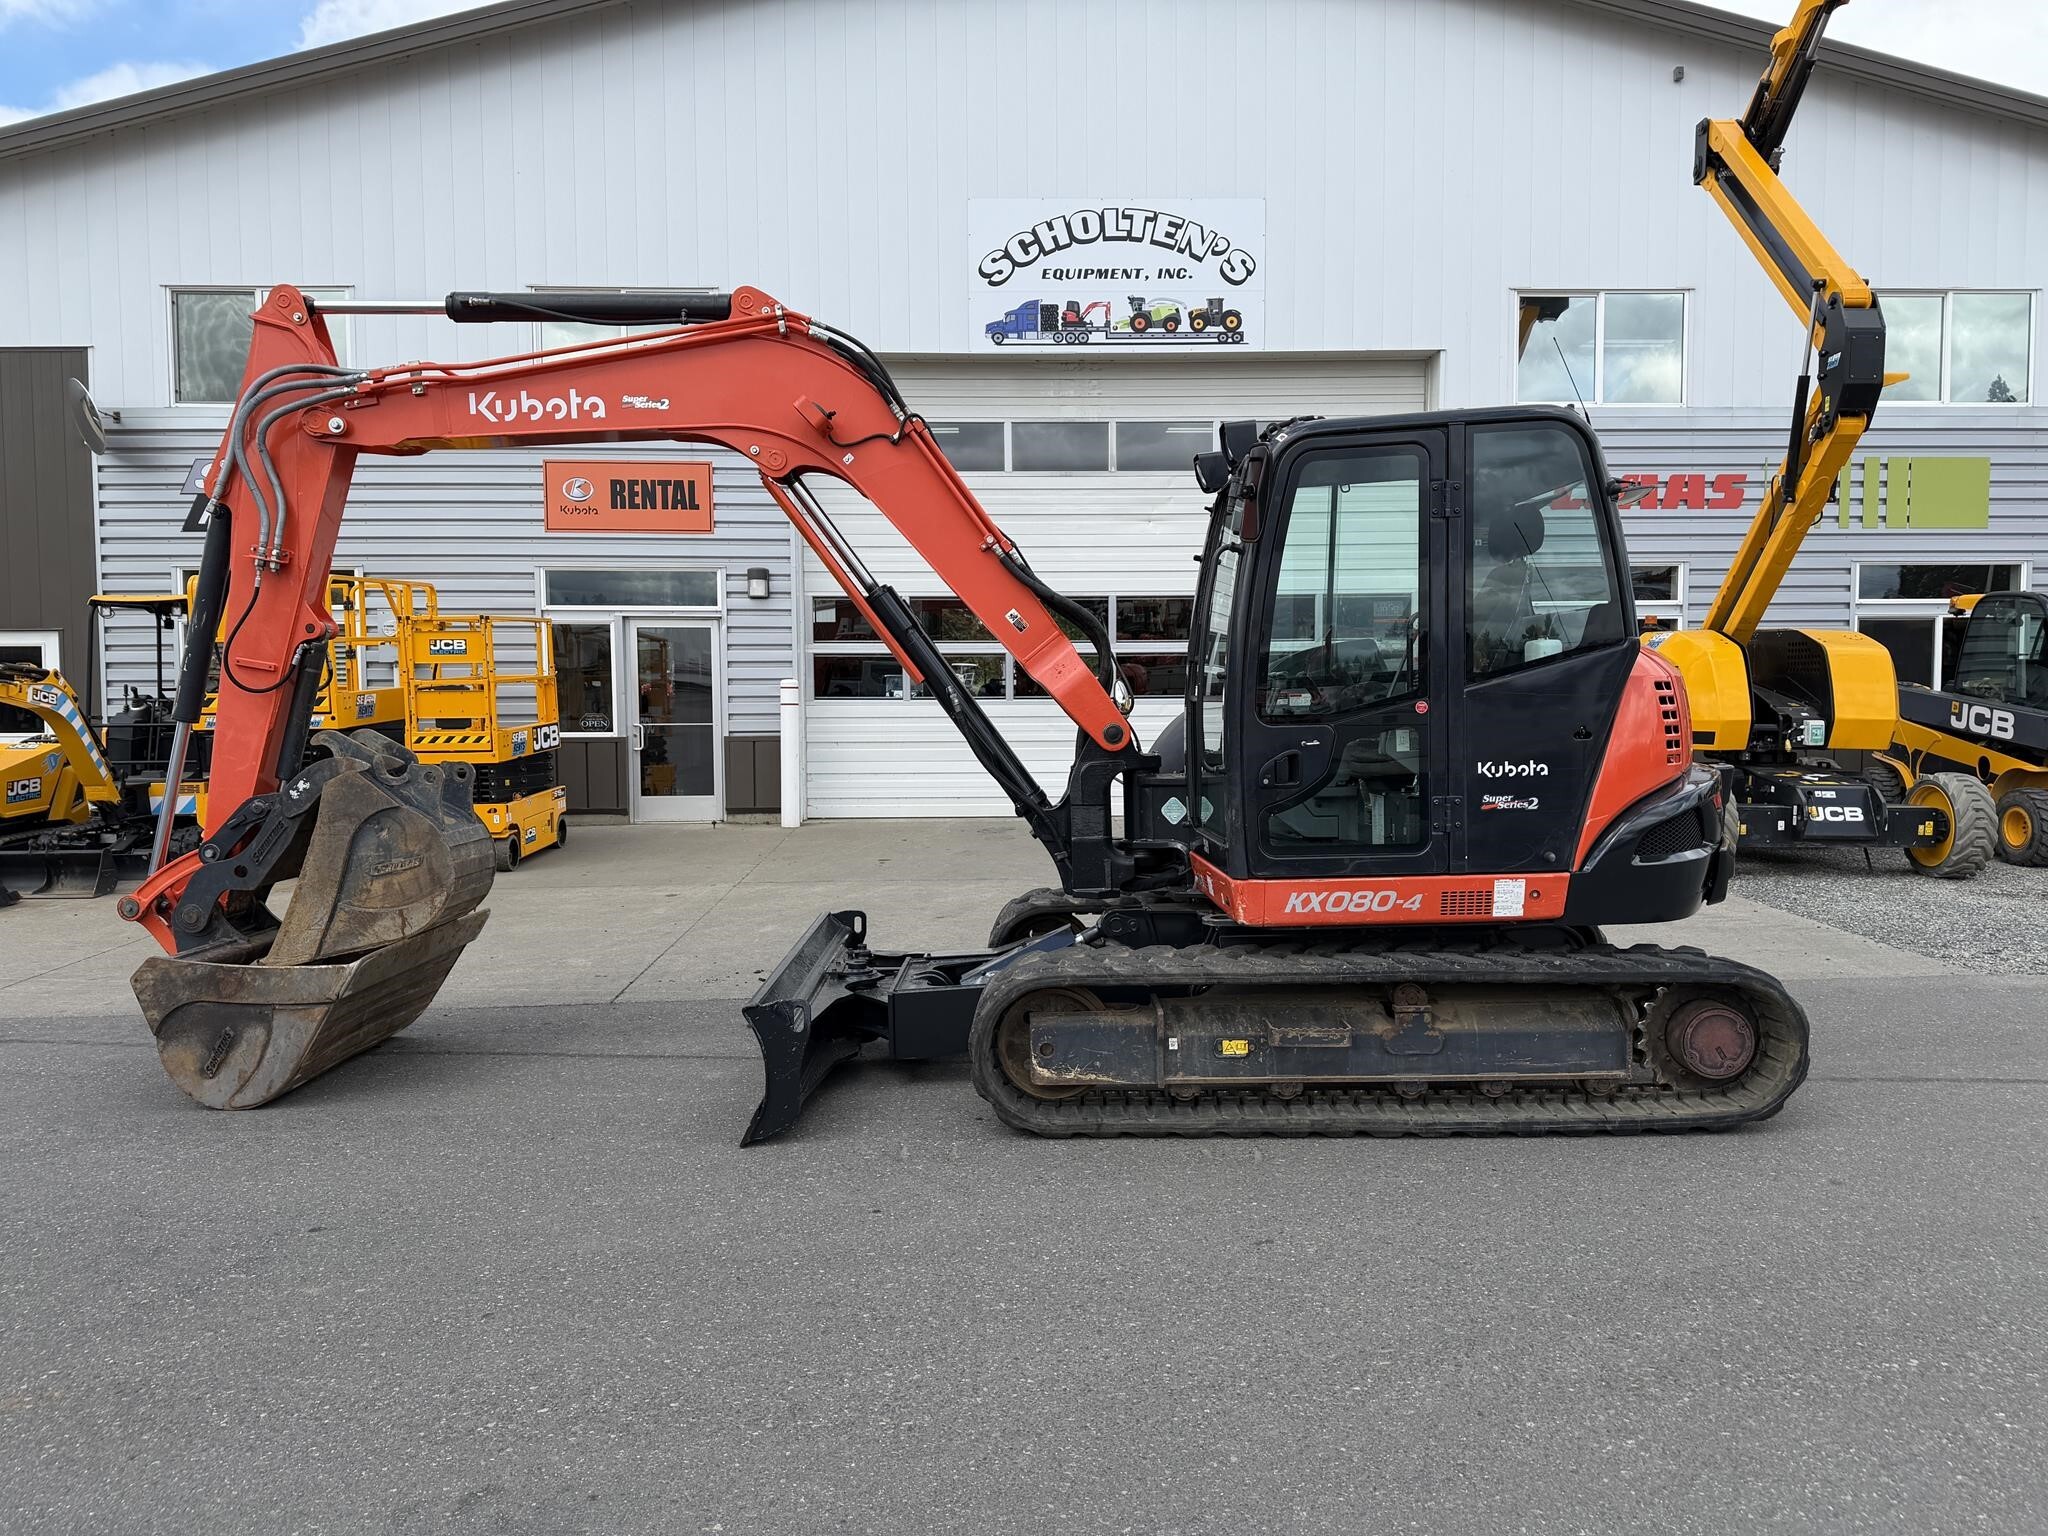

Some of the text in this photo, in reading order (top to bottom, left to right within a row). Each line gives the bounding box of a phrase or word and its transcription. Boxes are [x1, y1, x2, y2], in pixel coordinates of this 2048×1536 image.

[978, 207, 1256, 287] SCHOLTEN'S
[1041, 267, 1193, 282] EQUIPMENT, INC.
[468, 388, 606, 423] Kubota
[622, 394, 648, 404] Super
[609, 479, 700, 511] RENTAL
[559, 504, 599, 516] Kubota
[430, 639, 466, 650] JCB
[33, 688, 58, 705] JCB
[581, 720, 608, 728] OPEN
[1950, 702, 2016, 740] JCB
[533, 724, 560, 751] JCB
[1477, 759, 1549, 778] Kubota
[7, 778, 41, 796] JCB
[1482, 794, 1514, 804] Super
[1809, 806, 1864, 822] JCB
[1284, 890, 1424, 913] KX080-4
